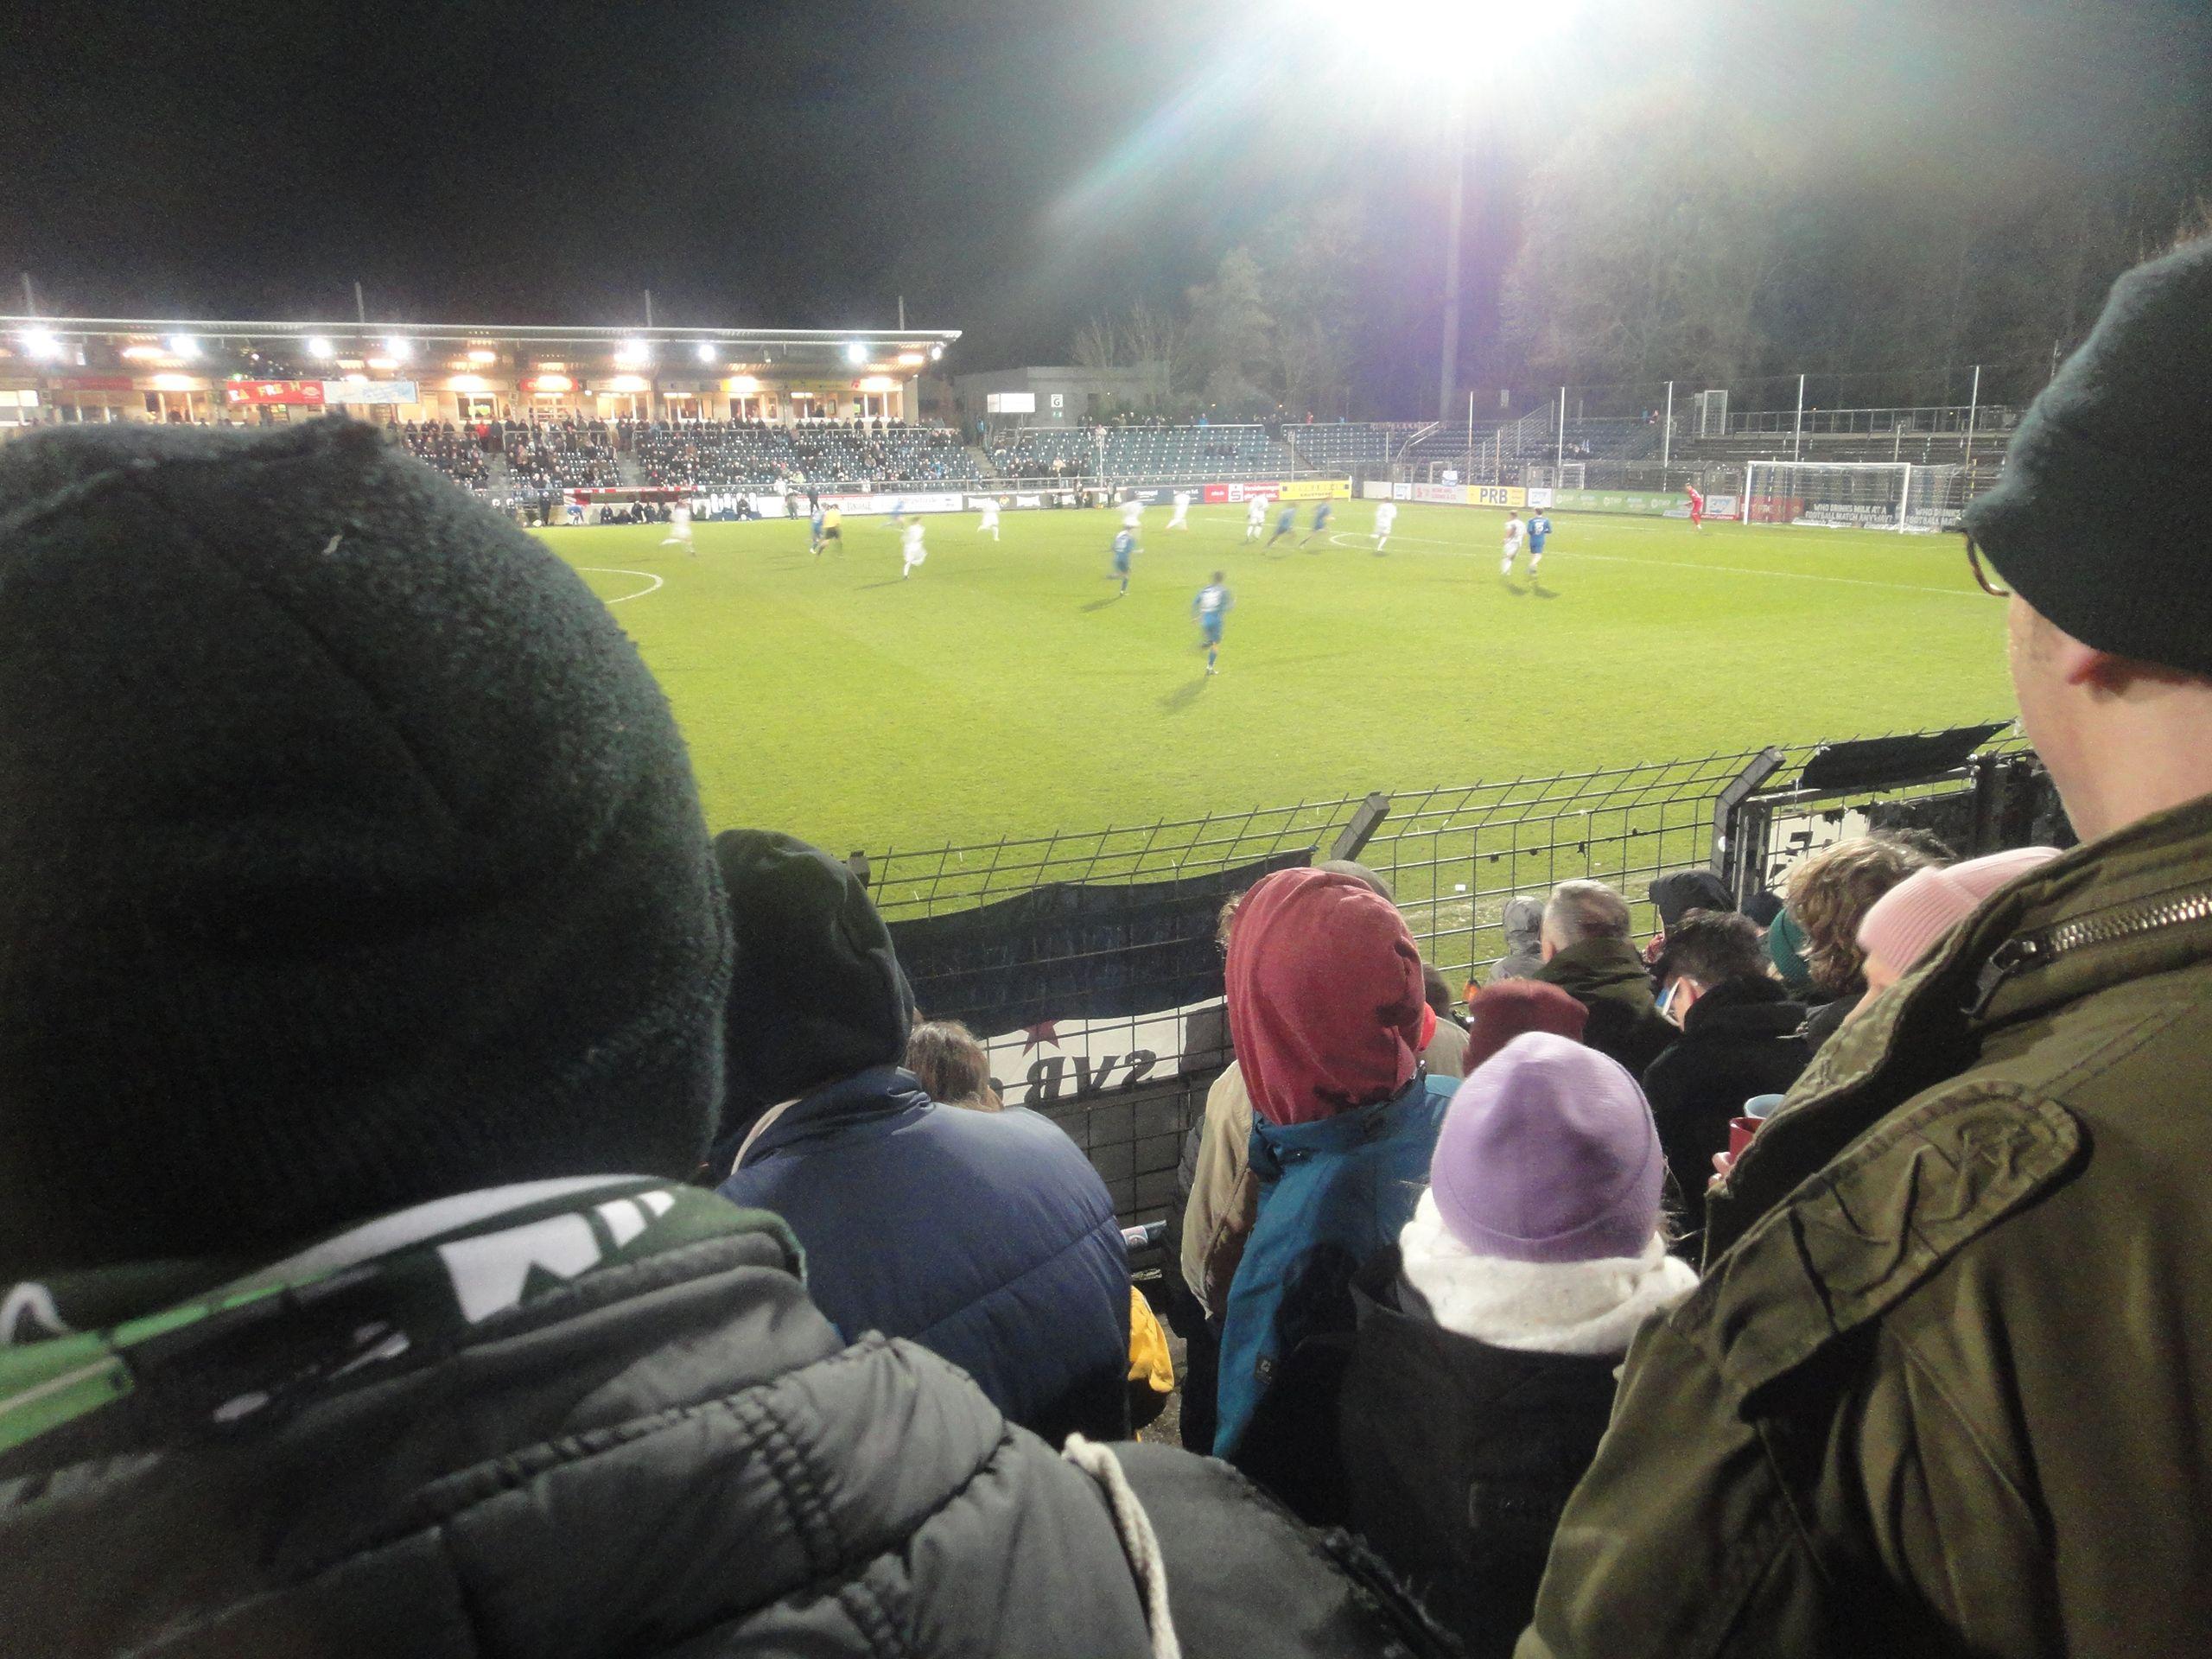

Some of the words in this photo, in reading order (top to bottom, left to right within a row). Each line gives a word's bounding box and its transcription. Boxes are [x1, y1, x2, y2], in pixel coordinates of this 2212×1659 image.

[1053, 397, 1060, 406] G
[1479, 487, 1508, 504] PRB
[1814, 503, 1829, 512] WHO
[1854, 505, 1871, 513] MILK
[1805, 511, 1835, 520] FOOTBALL
[1835, 512, 1858, 521] MATCH
